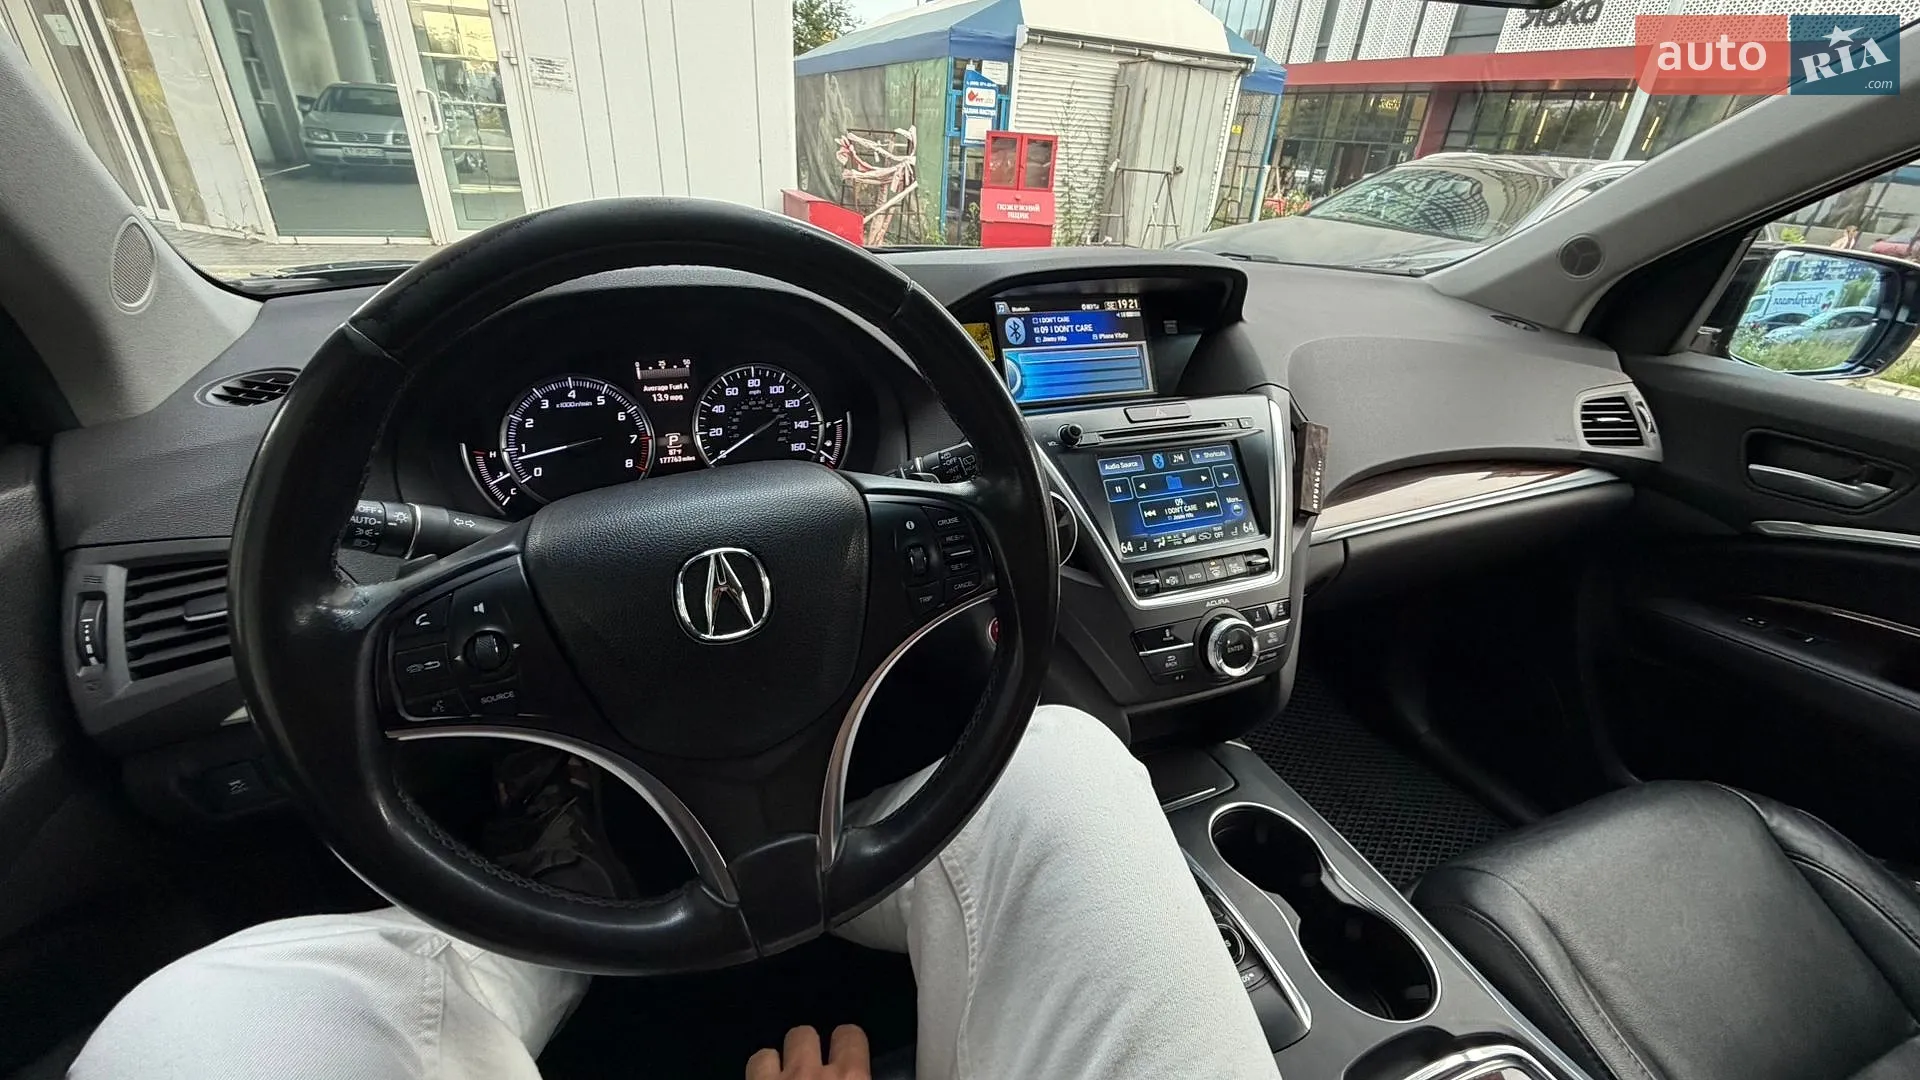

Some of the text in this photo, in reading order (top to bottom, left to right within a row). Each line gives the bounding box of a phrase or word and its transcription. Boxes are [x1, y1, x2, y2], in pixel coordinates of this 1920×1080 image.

[1040, 326, 1049, 334] 09
[1054, 325, 1074, 333] DON'T
[1075, 324, 1093, 332] CARE
[747, 378, 760, 388] 80
[643, 384, 668, 392] Average
[726, 387, 739, 396] 60
[769, 385, 785, 395] 100
[568, 390, 576, 399] 4
[652, 393, 683, 402] 13.9 mpg
[541, 400, 549, 409] 3
[597, 396, 606, 405] 5
[785, 399, 800, 408] 120
[712, 404, 725, 414] 40
[617, 412, 626, 421] 6
[525, 418, 534, 428] 2
[794, 420, 809, 430] 140
[709, 428, 723, 437] 20
[629, 435, 638, 444] 7
[521, 444, 526, 452] 1
[791, 443, 806, 452] 160
[1203, 451, 1226, 459] Shortcuts
[625, 459, 633, 468] 8
[659, 456, 681, 464] 177763
[945, 457, 957, 466] OFF
[1105, 460, 1138, 470] Audio Source
[534, 468, 542, 477] 0
[510, 487, 517, 495] C
[357, 505, 377, 514] OFF
[1168, 506, 1183, 514] DON'T
[1184, 504, 1198, 512] CARE
[350, 516, 376, 525] AUTO
[937, 516, 960, 526] CRUISE
[1243, 522, 1254, 533] 64
[1214, 531, 1224, 539] OFF
[1120, 541, 1133, 554] 64
[1188, 572, 1202, 580] AUTO
[1205, 598, 1230, 608] ACURA
[481, 691, 516, 705] SOURCE
